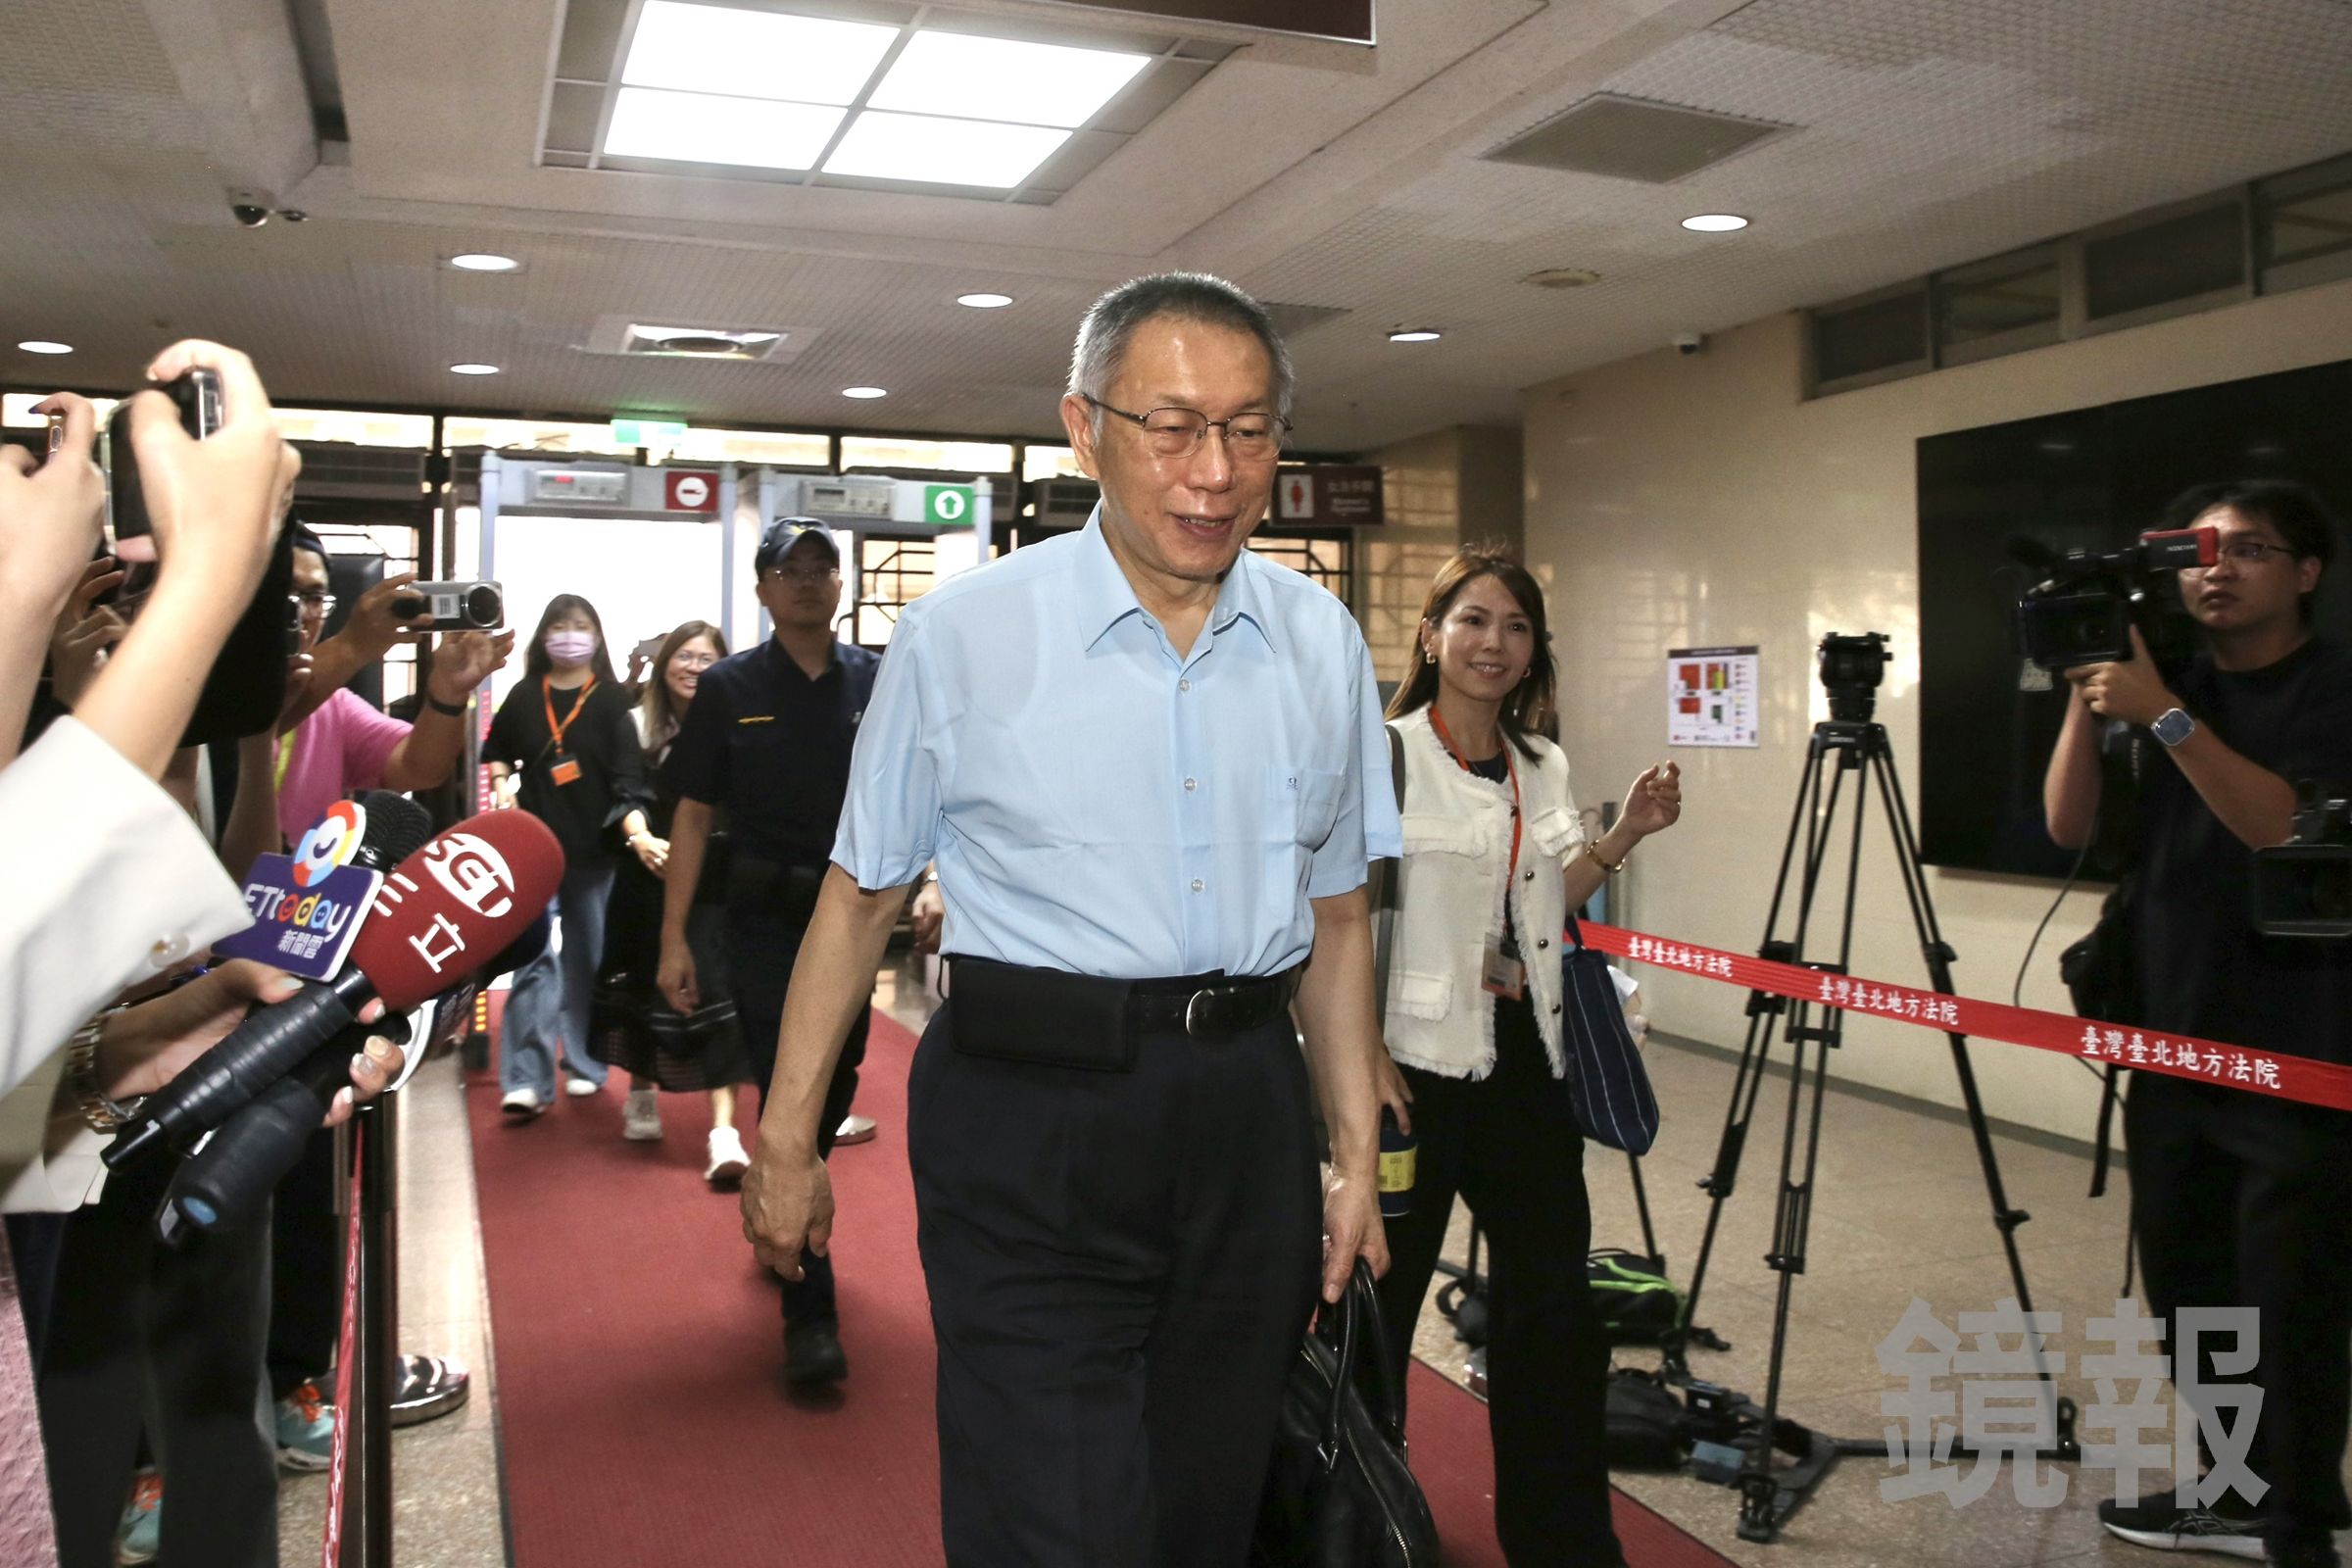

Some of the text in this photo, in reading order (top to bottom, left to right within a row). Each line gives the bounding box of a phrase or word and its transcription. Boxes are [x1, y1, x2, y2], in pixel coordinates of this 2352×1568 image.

[277, 929, 324, 959] 新聞雲
[374, 872, 466, 974] 三立
[1628, 936, 1733, 978] 臺灣臺北地方法院
[1819, 975, 1959, 1026] 臺灣臺北地方法院
[2081, 1025, 2282, 1090] 臺灣臺北地方法院
